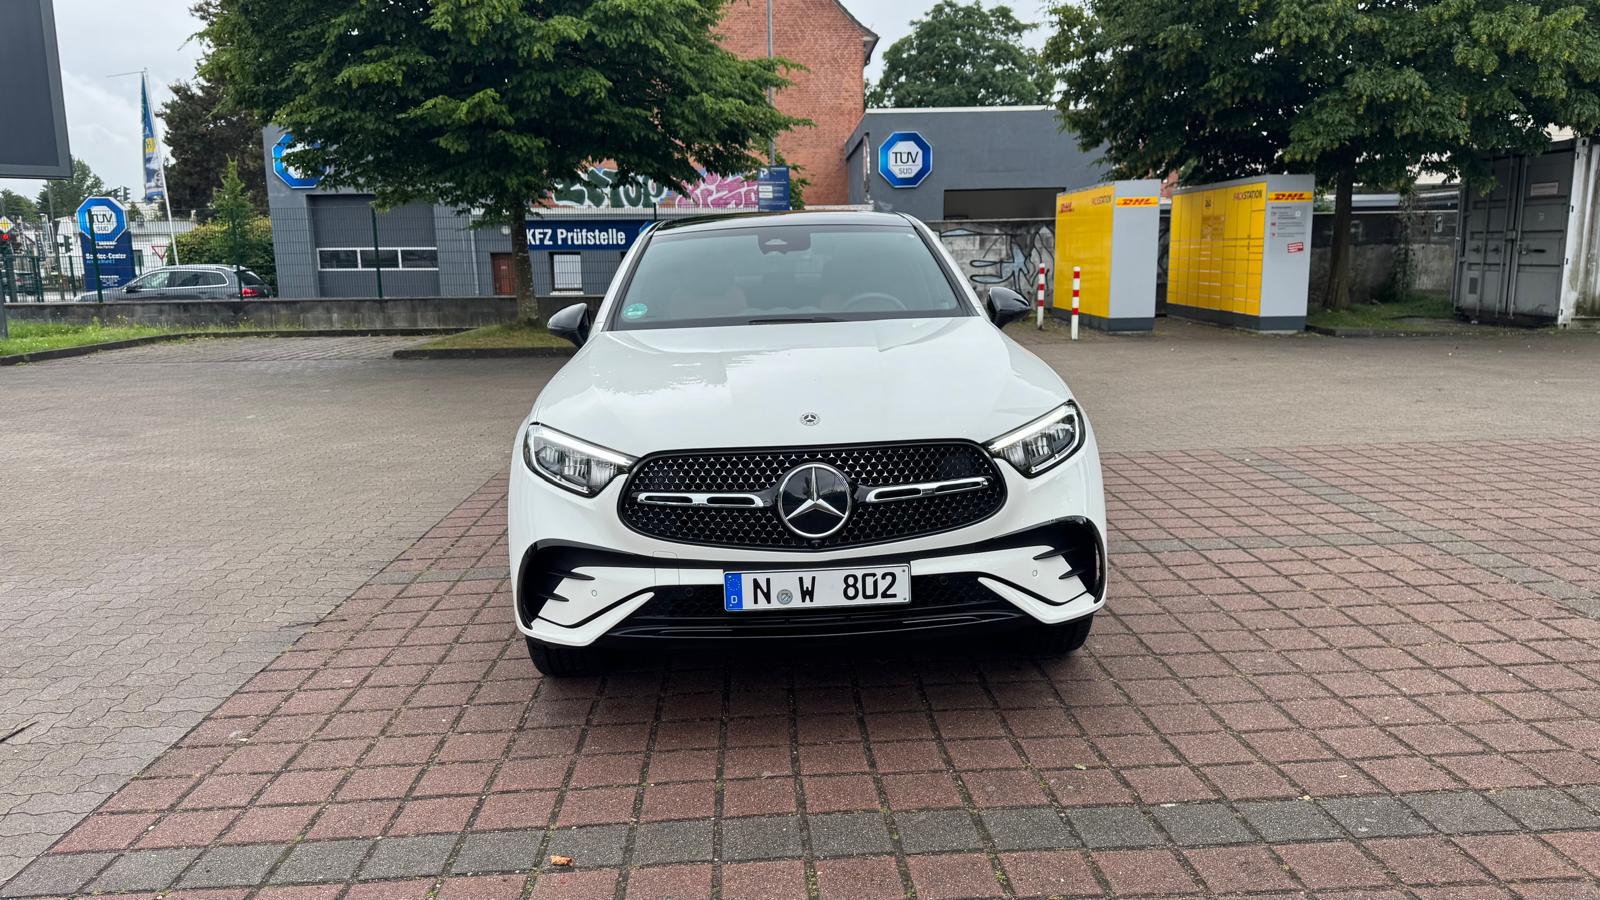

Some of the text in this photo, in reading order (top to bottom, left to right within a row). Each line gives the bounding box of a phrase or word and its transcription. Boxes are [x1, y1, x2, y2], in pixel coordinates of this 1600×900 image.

[892, 151, 919, 164] TÜV
[898, 167, 913, 175] SÜD
[1274, 193, 1305, 201] DHL
[1122, 198, 1153, 206] DHL
[526, 228, 626, 246] KFZ Prüfstelle
[752, 571, 898, 605] N W 802
[731, 595, 738, 604] D
